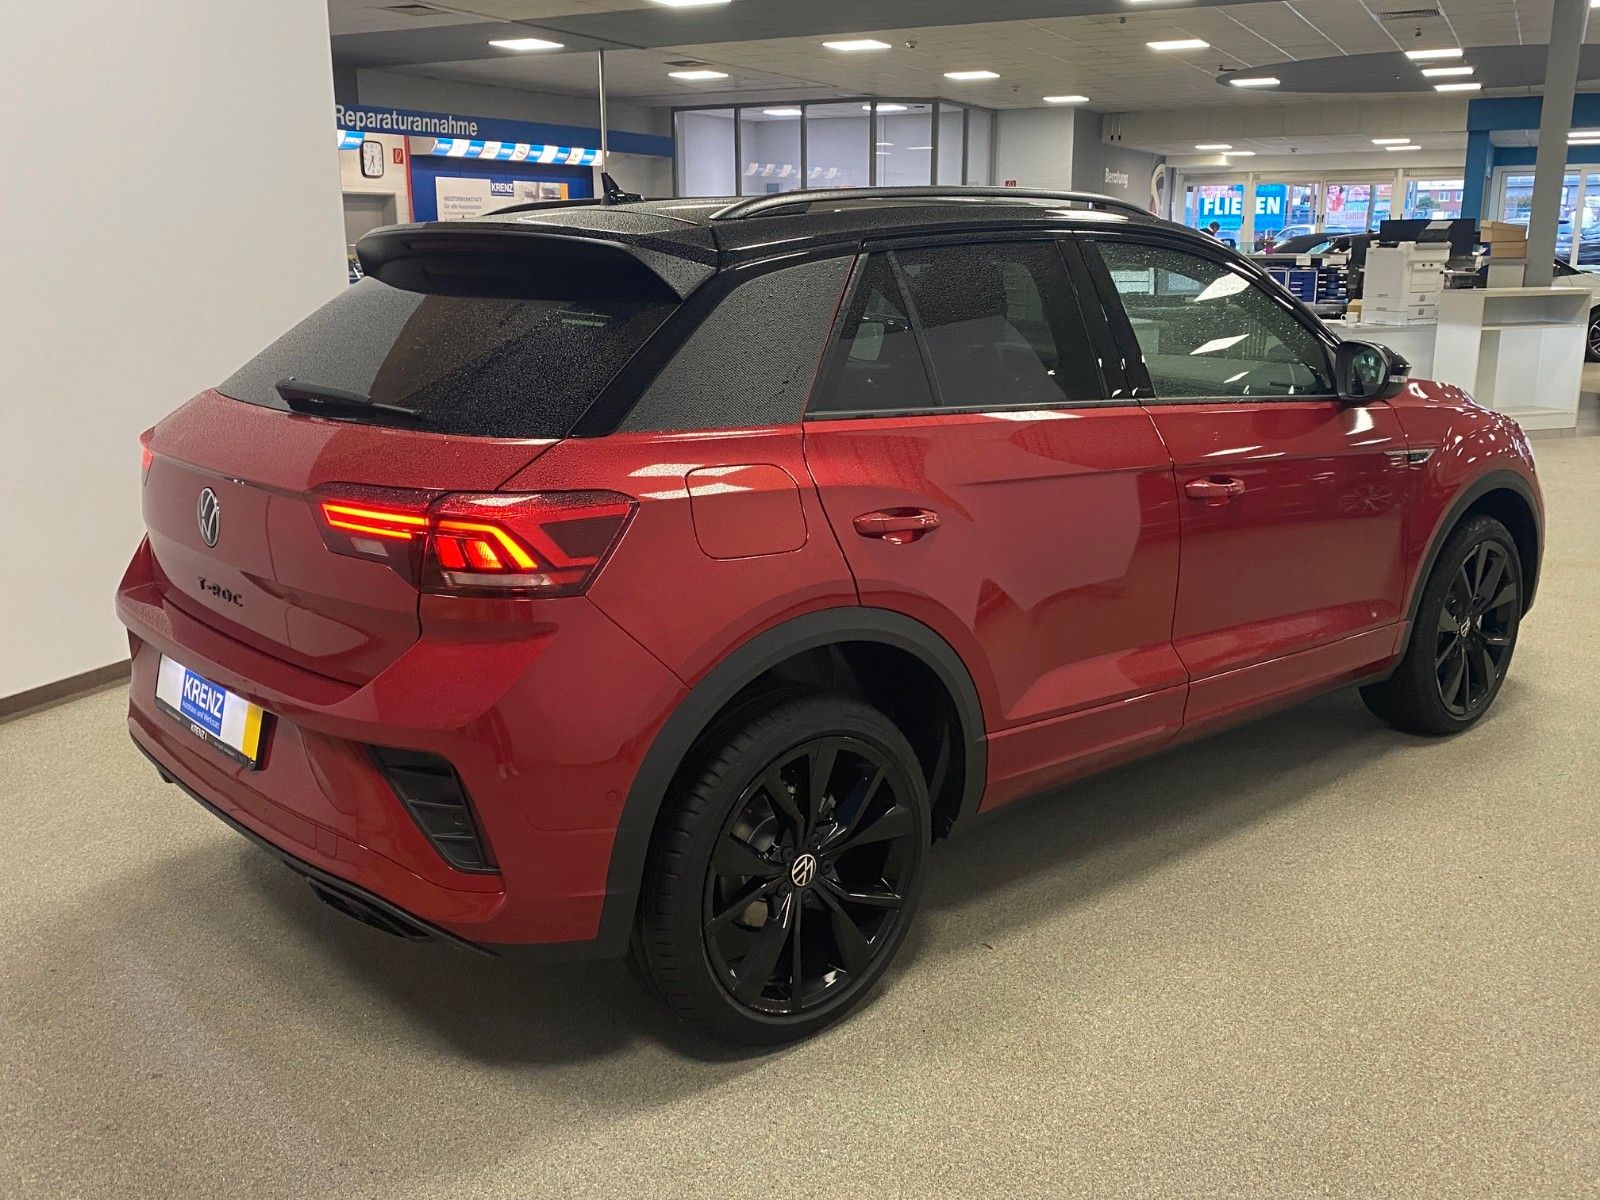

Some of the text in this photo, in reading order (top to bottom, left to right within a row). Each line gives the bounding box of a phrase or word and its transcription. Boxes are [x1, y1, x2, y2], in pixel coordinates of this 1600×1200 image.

[335, 105, 478, 136] Reparaturannahme
[491, 183, 514, 193] KRENZ
[198, 576, 243, 607] T-ROC
[183, 674, 224, 719] KRENZ
